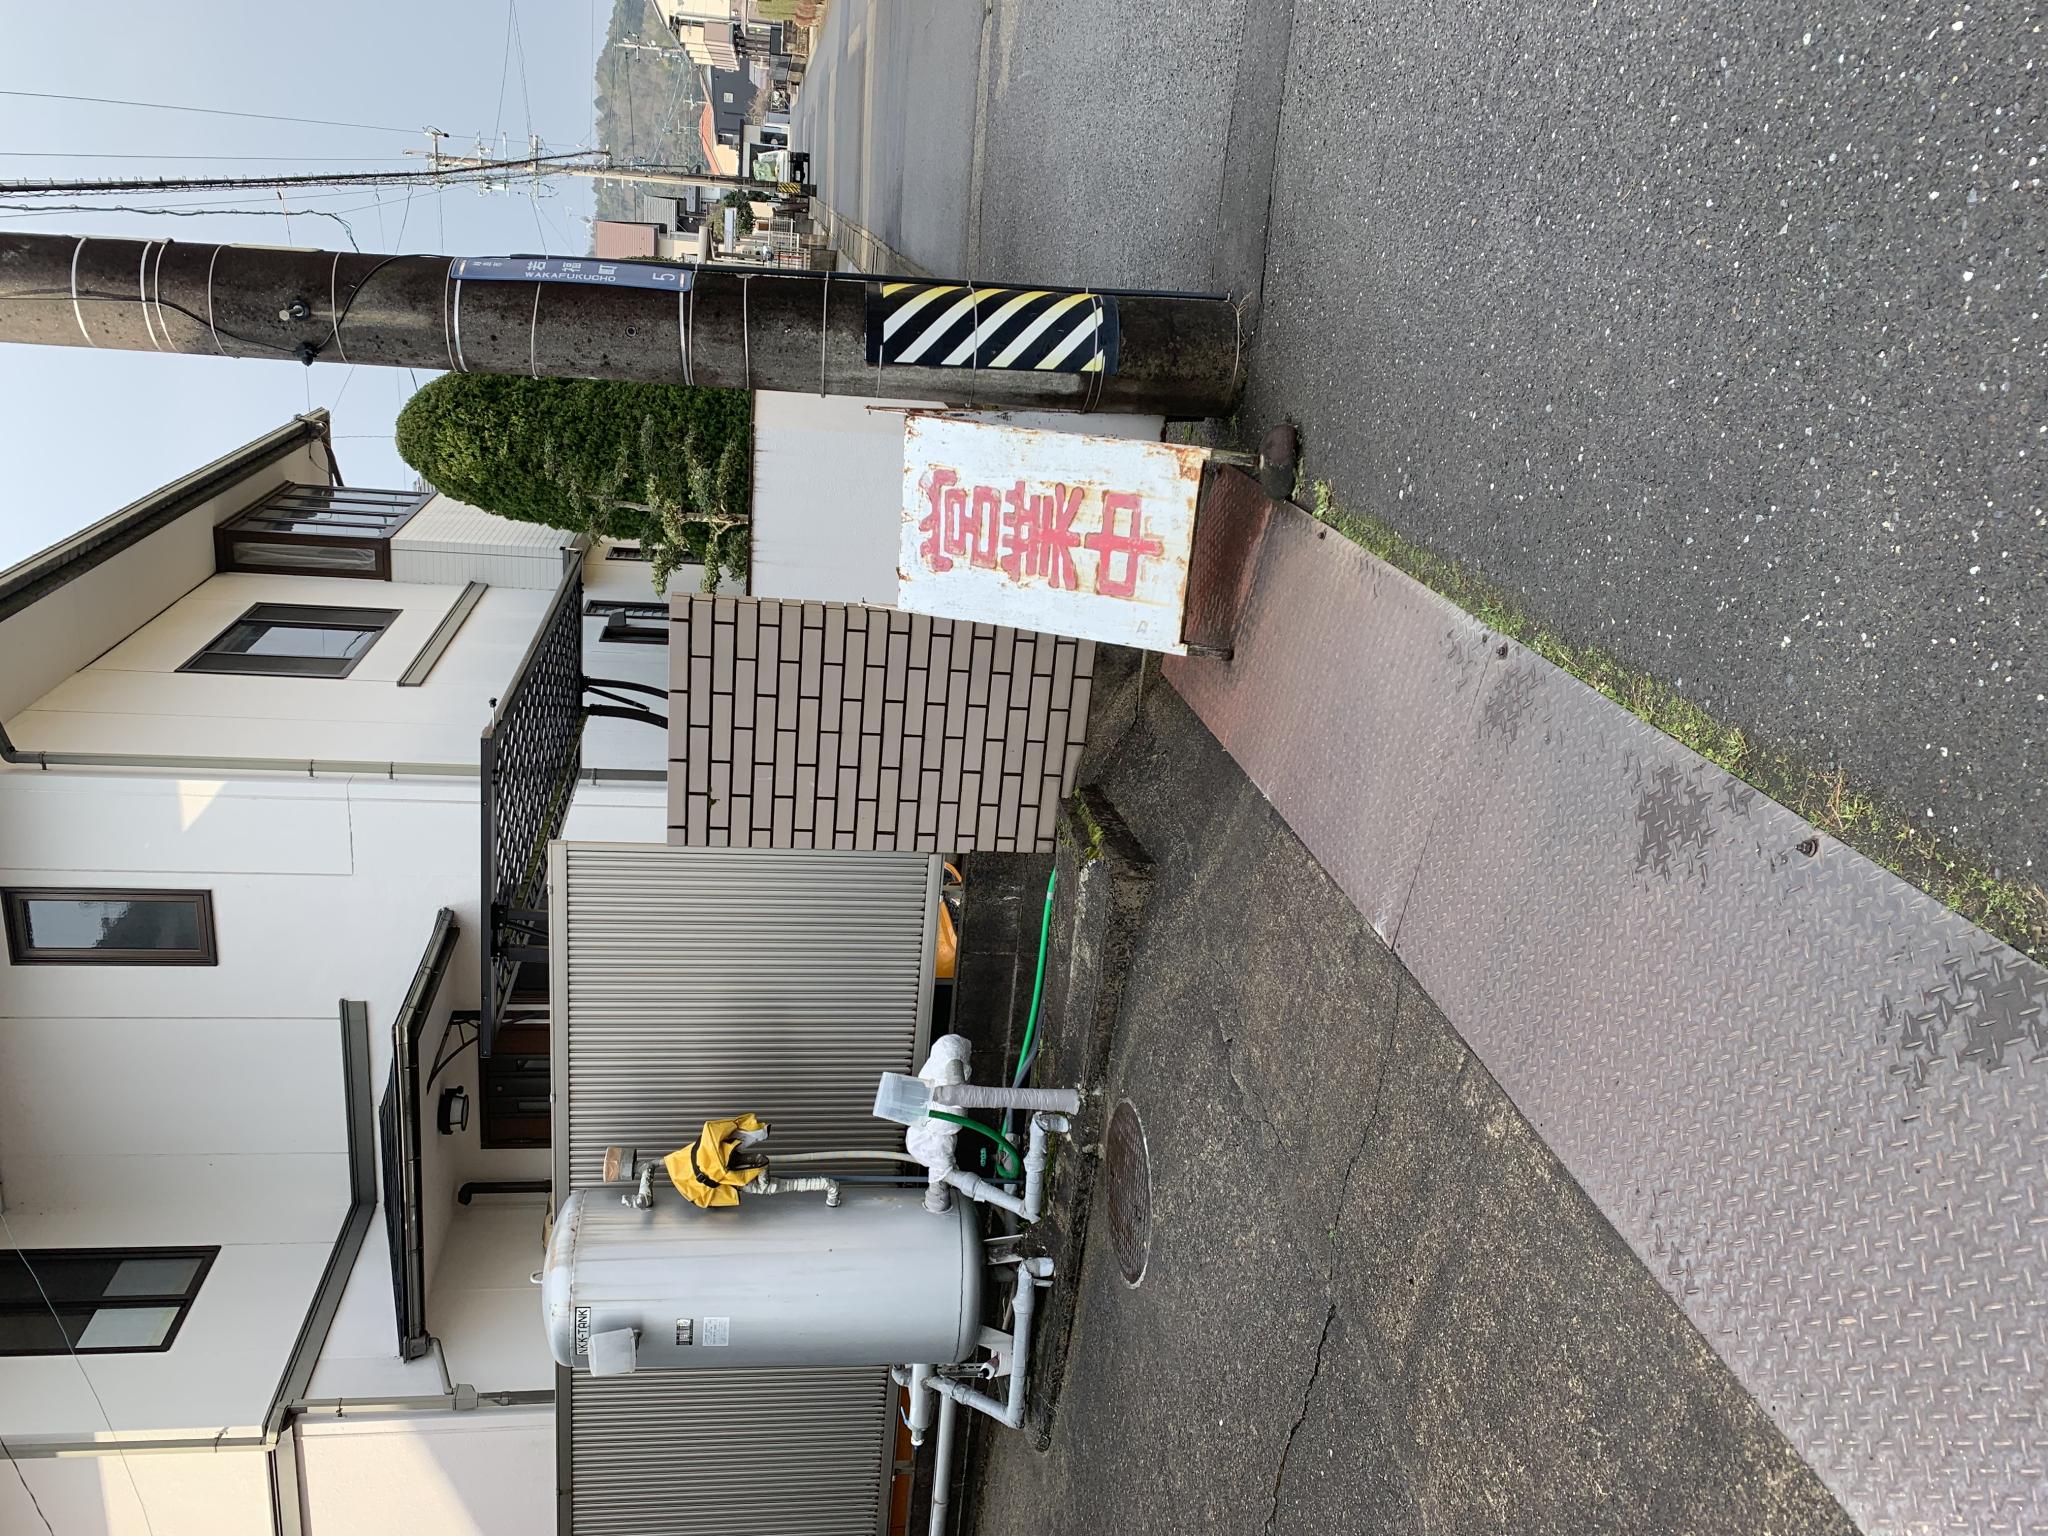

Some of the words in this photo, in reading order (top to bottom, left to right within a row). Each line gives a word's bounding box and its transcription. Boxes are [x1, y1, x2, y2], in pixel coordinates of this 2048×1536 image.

[525, 271, 616, 282] WAKAFUKUCHO
[652, 272, 676, 281] 5
[919, 469, 1164, 597] 営業中
[577, 1309, 589, 1354] NKK-TANK
